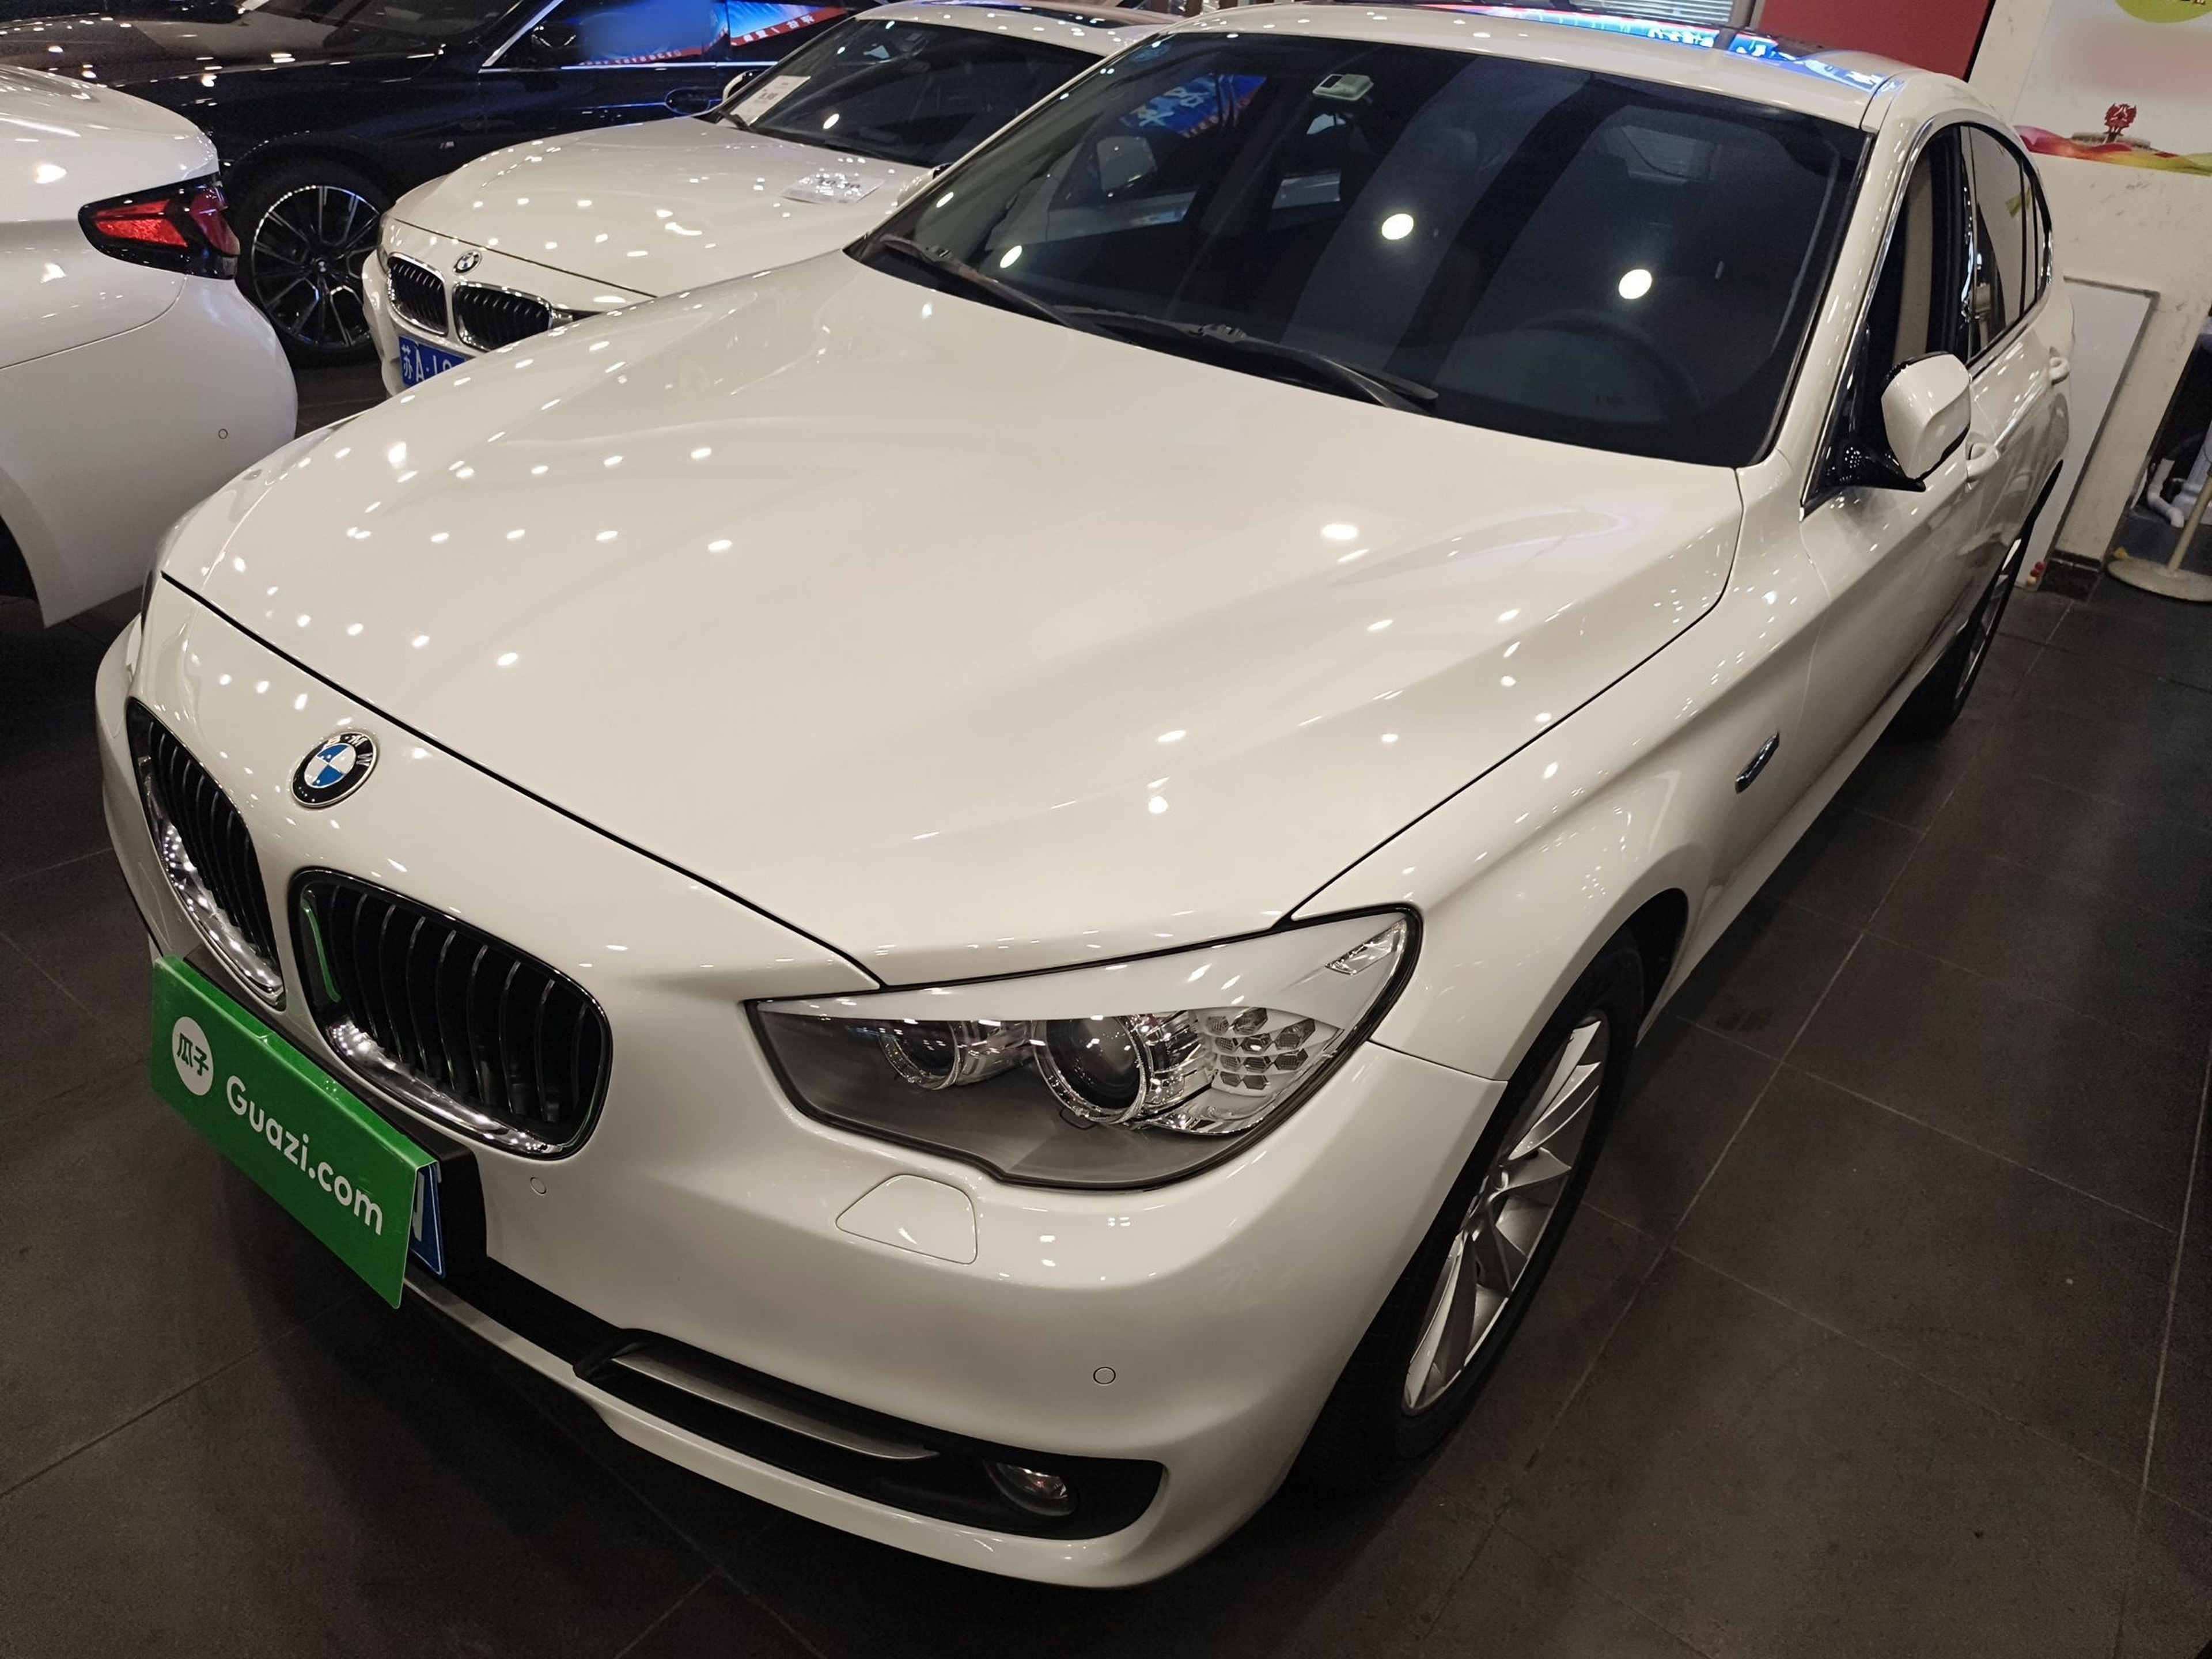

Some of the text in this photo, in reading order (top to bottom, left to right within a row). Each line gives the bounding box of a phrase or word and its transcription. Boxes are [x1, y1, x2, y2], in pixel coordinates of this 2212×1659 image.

[327, 734, 373, 767] BMW
[176, 1033, 209, 1076] 瓜子
[226, 1075, 383, 1236] Guazi.com
